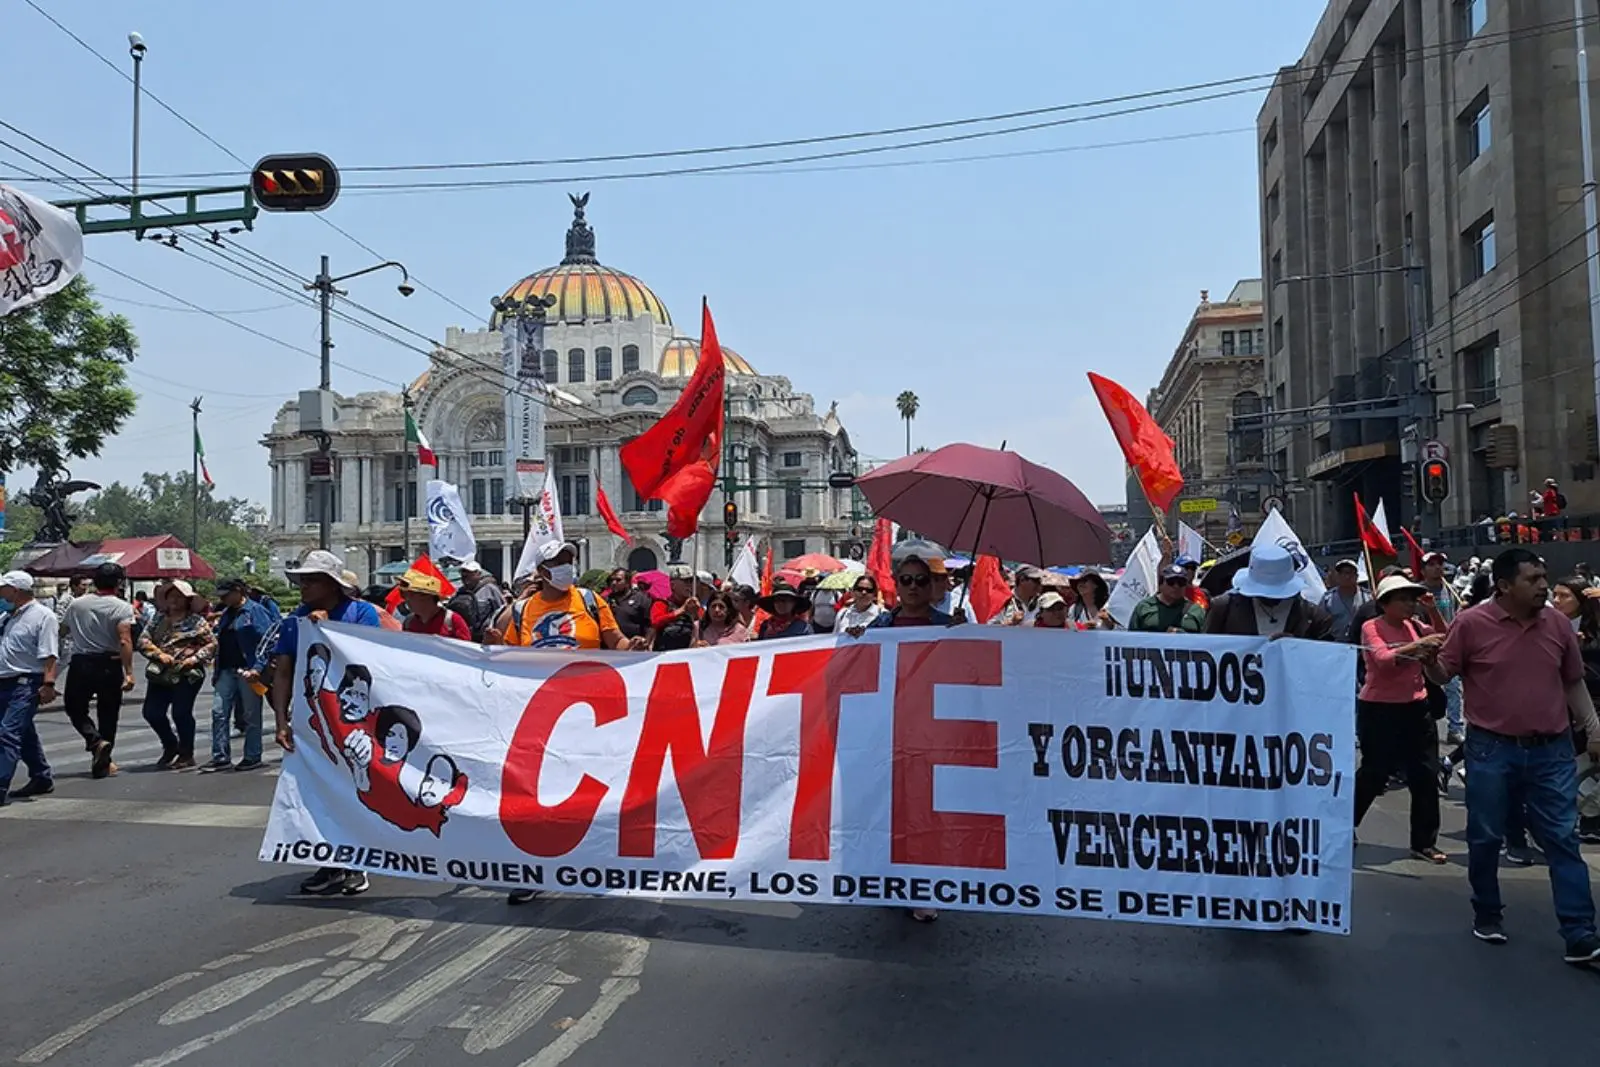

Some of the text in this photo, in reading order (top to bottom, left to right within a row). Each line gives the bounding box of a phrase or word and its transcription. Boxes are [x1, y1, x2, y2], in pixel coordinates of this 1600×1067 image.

[1105, 646, 1266, 705] ¡¡UNIDOS
[498, 641, 1006, 869] CNTE
[1028, 723, 1342, 797] Y ORGANIZADOS,
[273, 839, 438, 876] ¡¡GOBIERNE
[446, 858, 544, 885] QUIEN
[555, 866, 736, 898] GOBIERNE,
[750, 872, 818, 896] LOS
[832, 875, 1041, 908] DERECHOS
[1055, 887, 1103, 912] SE
[1047, 808, 1320, 877] VENCEREMOS!!
